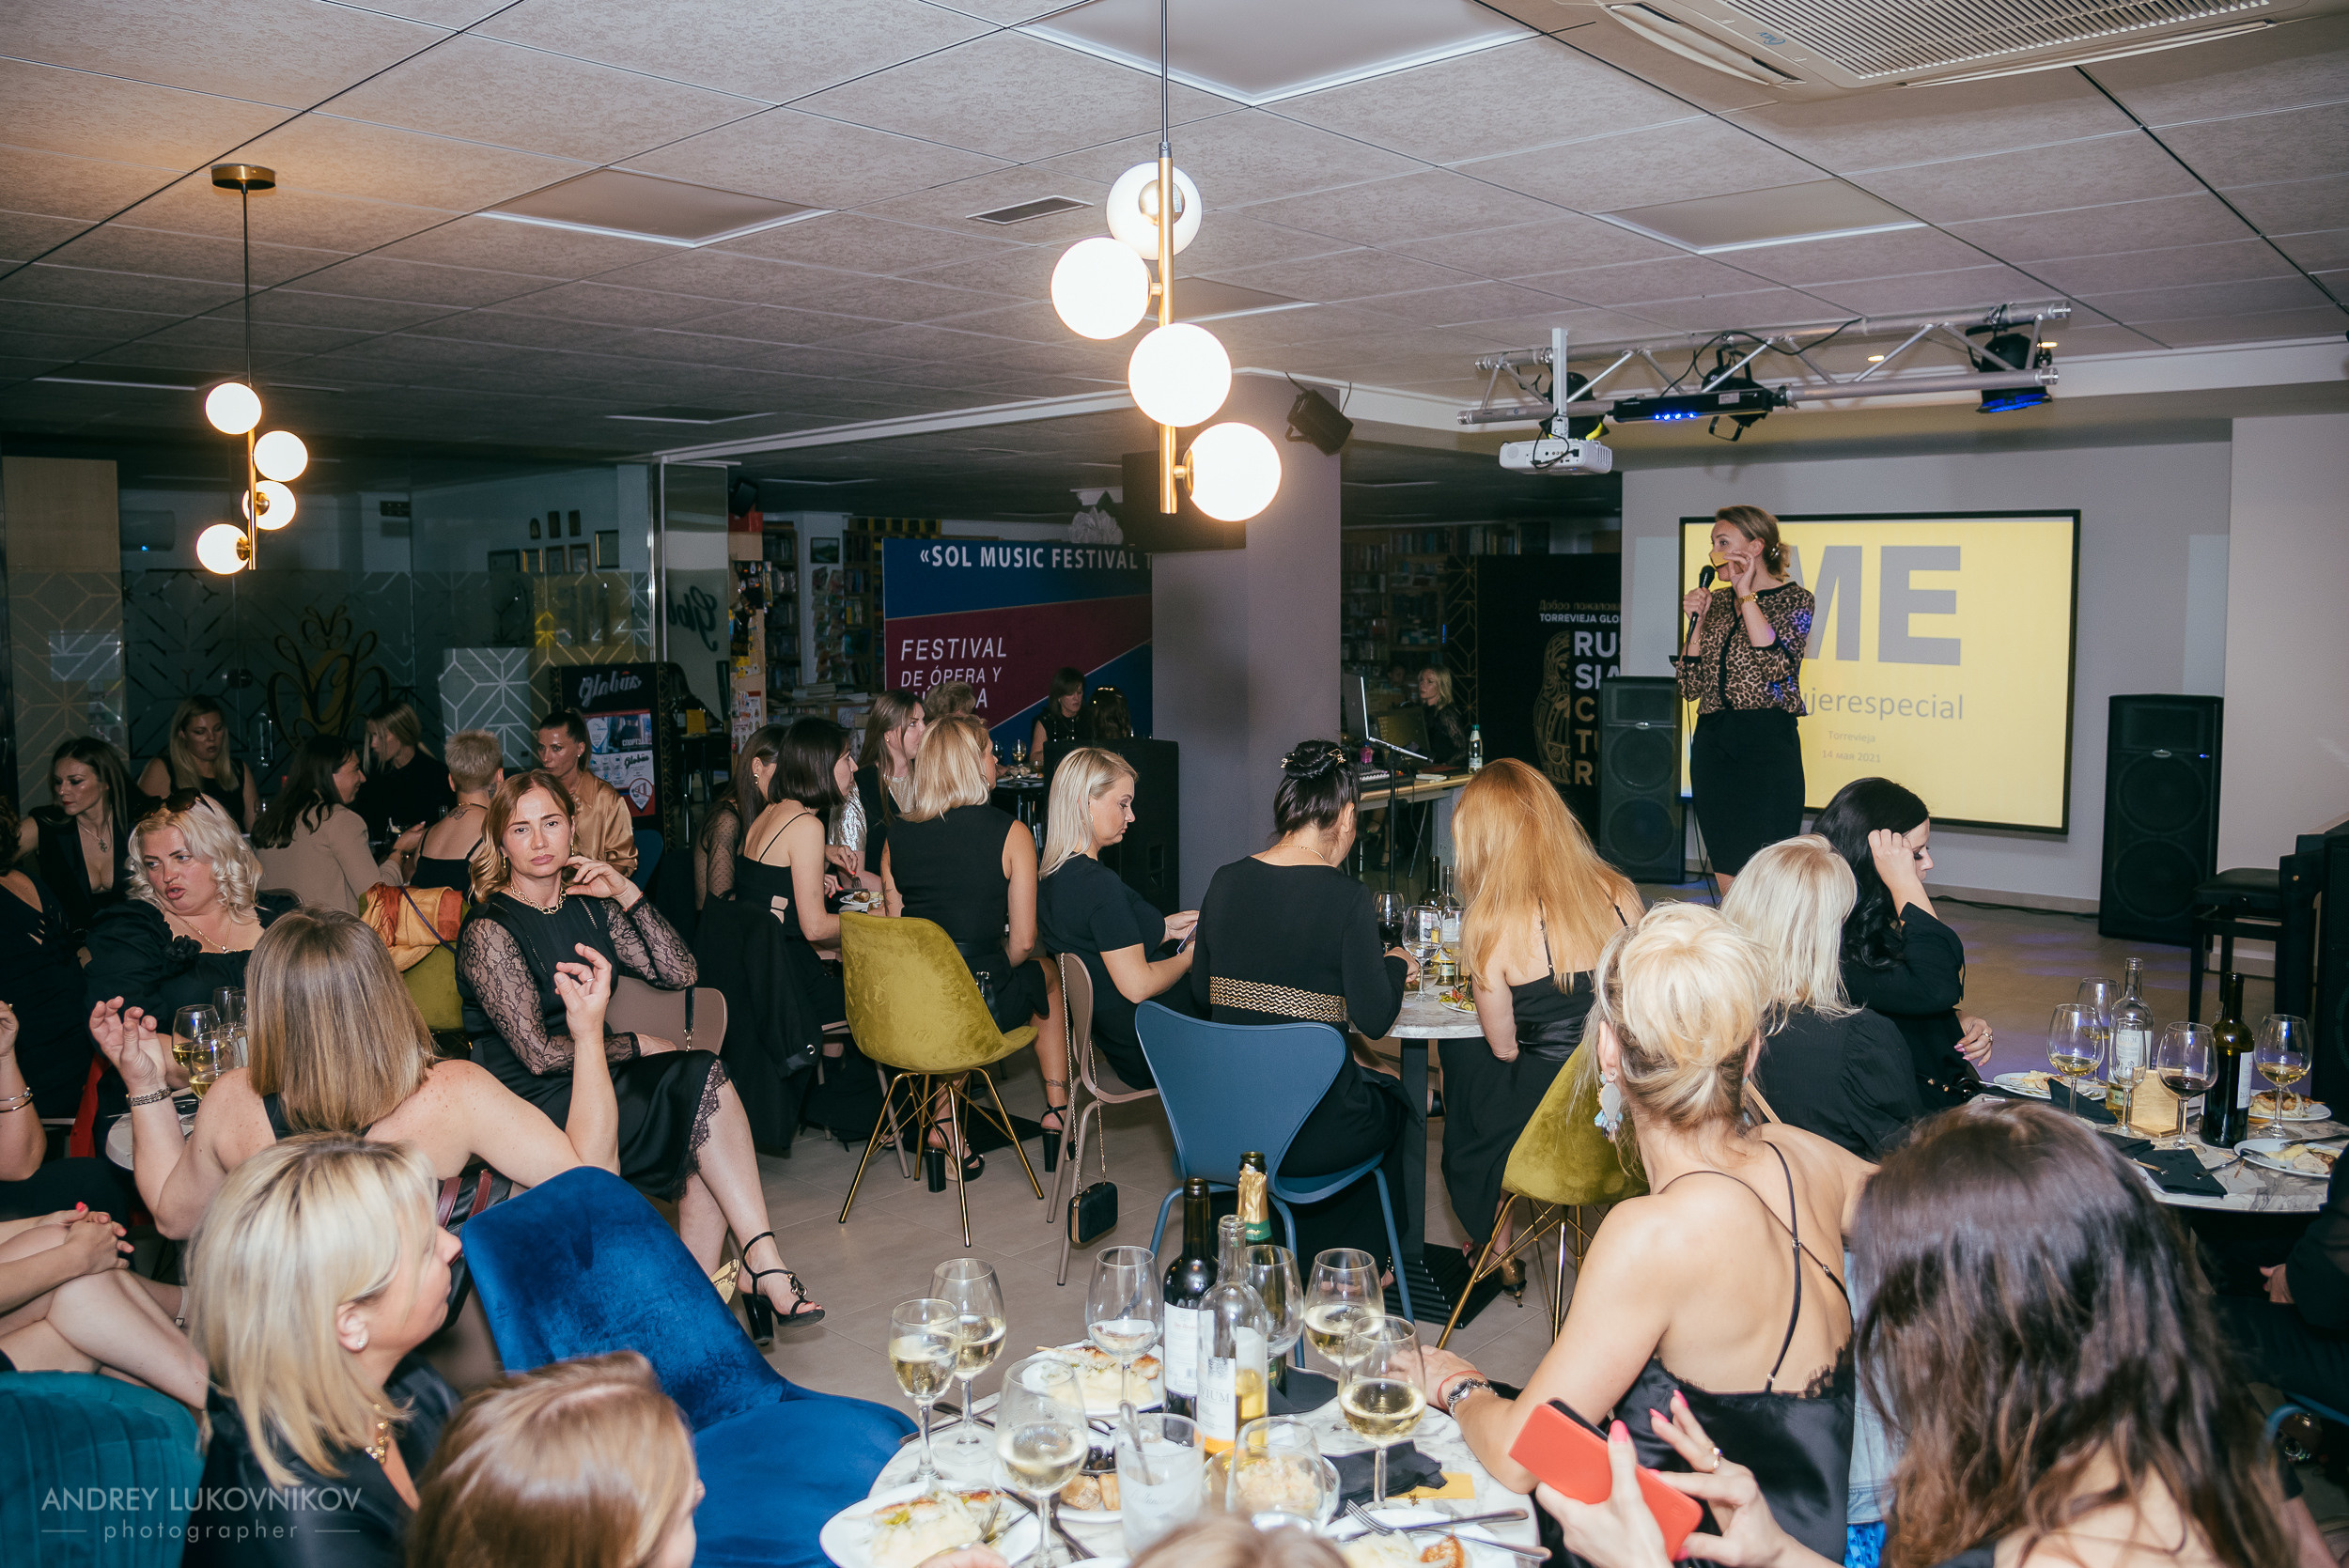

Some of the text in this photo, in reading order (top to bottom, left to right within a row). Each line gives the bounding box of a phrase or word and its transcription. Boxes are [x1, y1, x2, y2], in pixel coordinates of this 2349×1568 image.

[980, 546, 1044, 568] MUSIC
[1051, 548, 1139, 569] FESTIVAL
[1540, 613, 1620, 624] TORREVIEJA GLO
[901, 637, 1007, 661] FESTIVAL
[1574, 630, 1620, 658] RU
[901, 670, 924, 688] DE
[992, 666, 1003, 683] Y
[1828, 730, 1876, 744] Torrevieja
